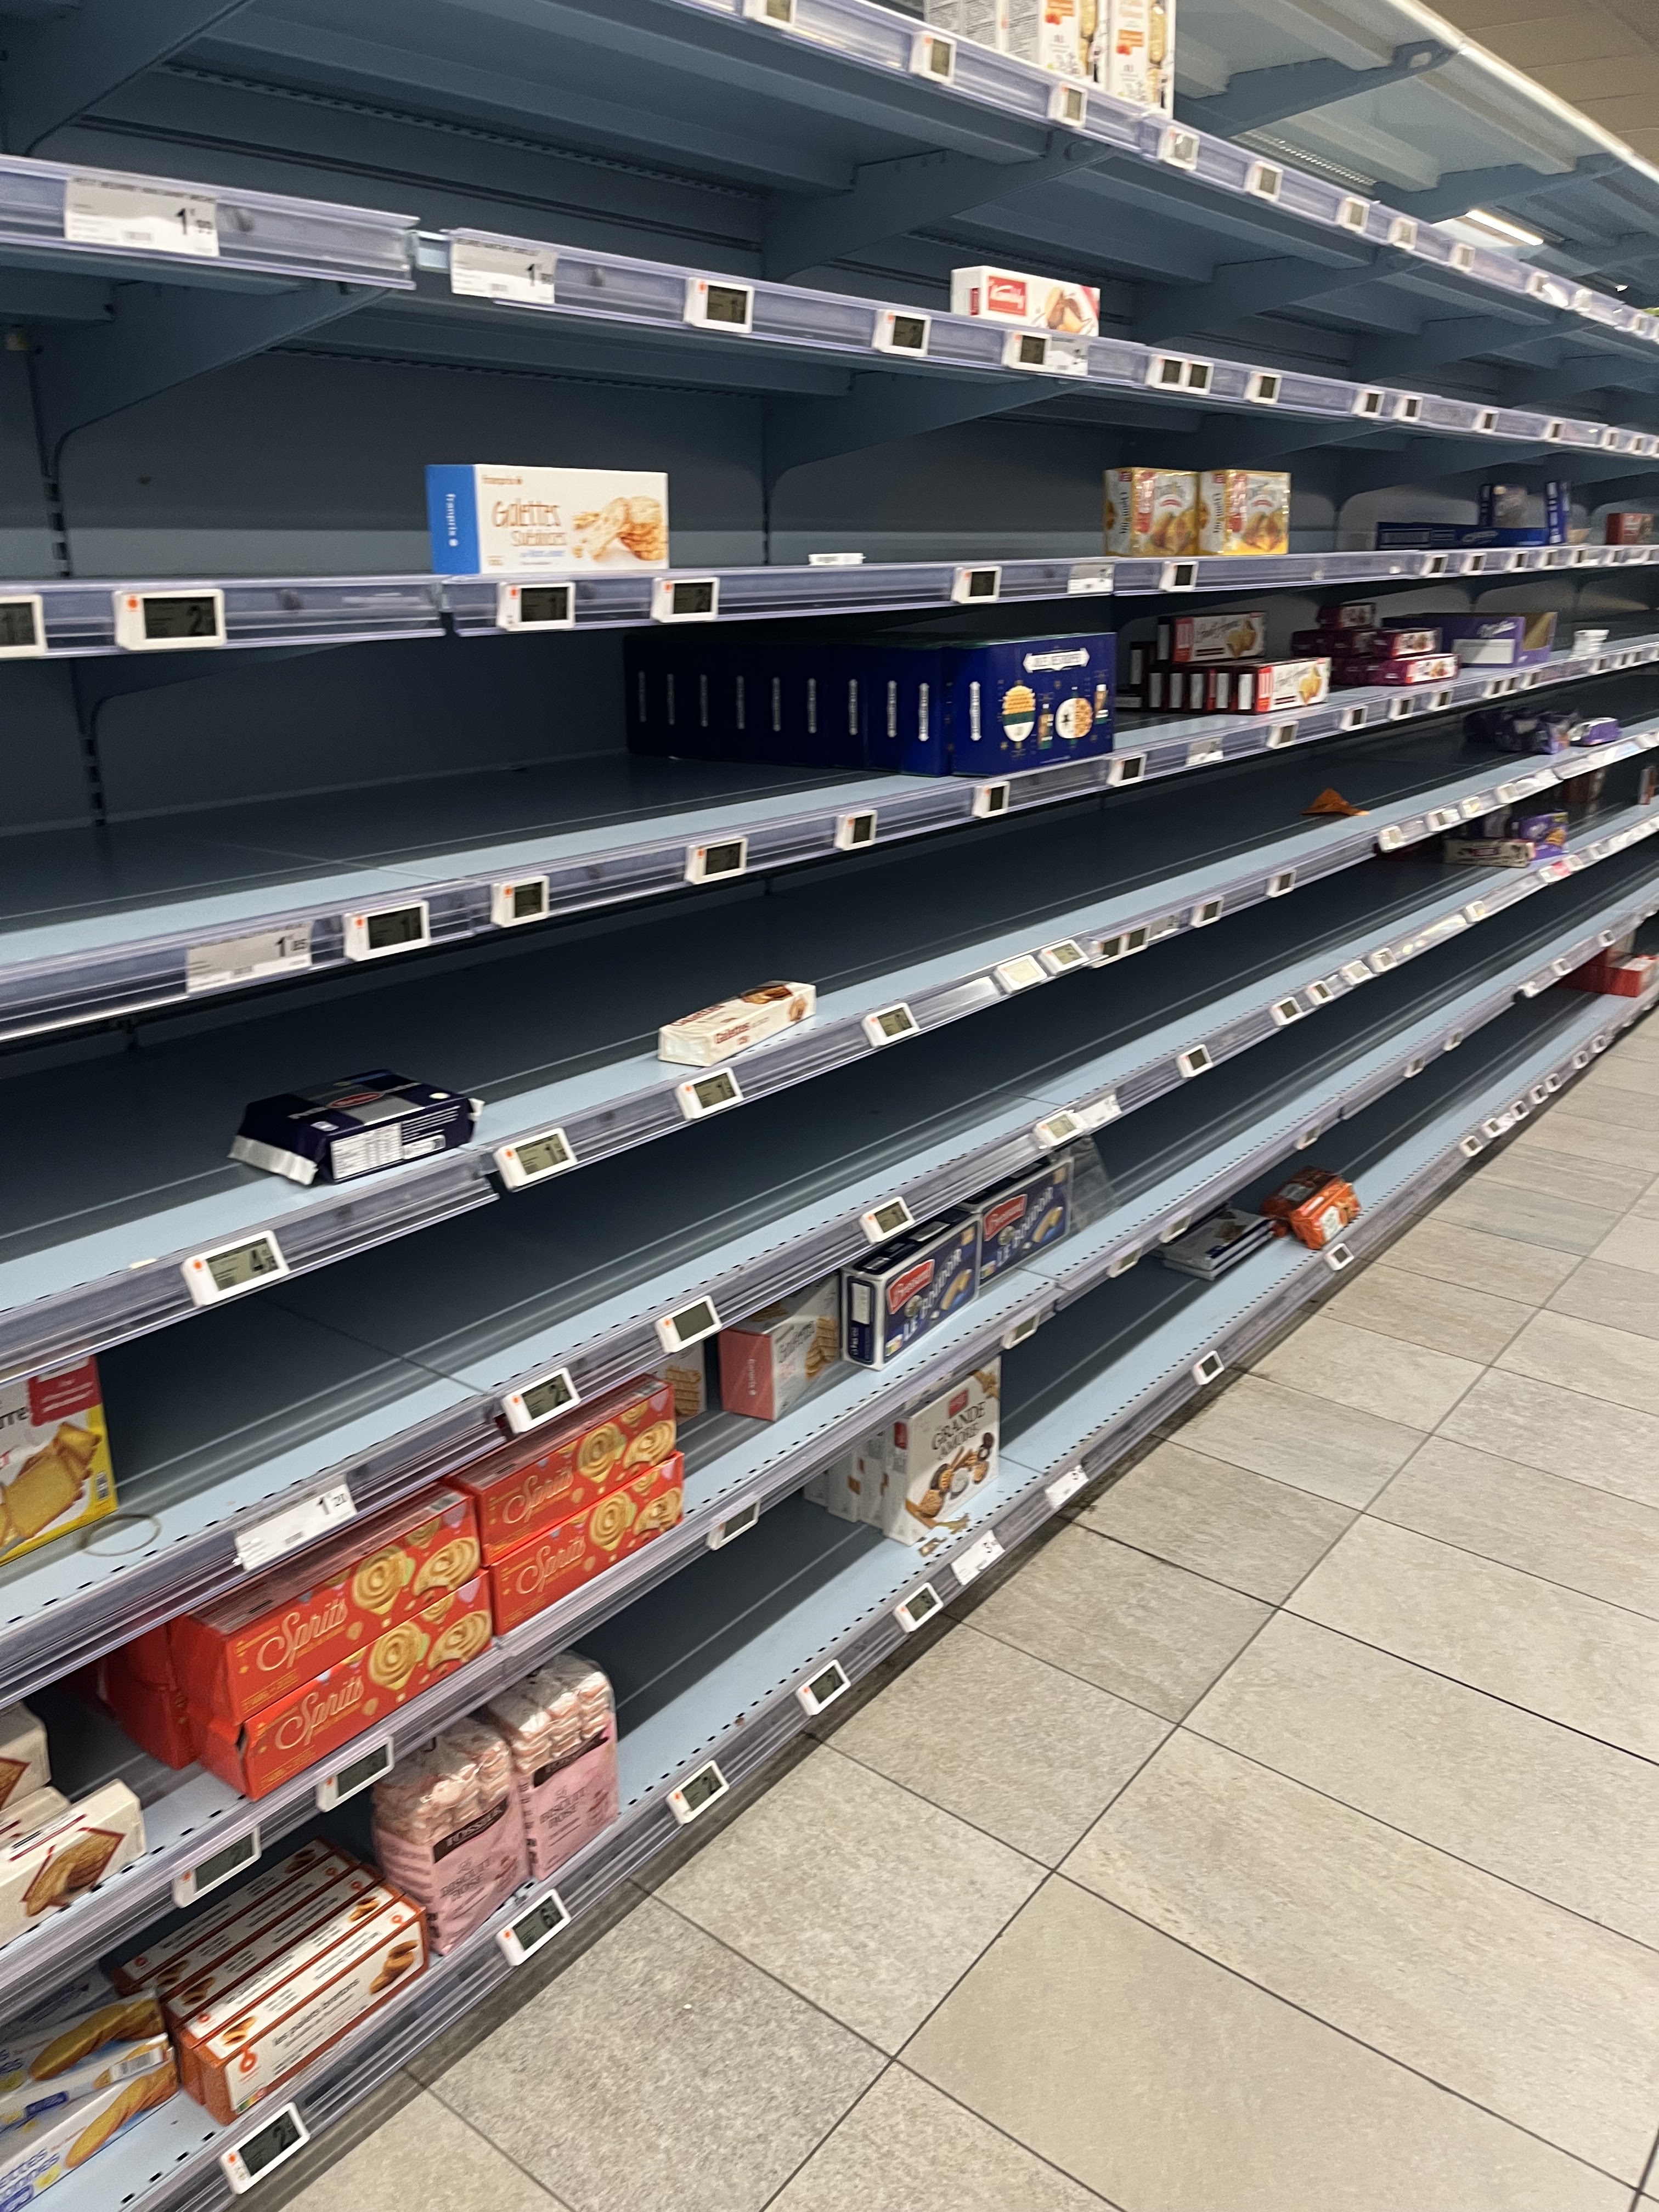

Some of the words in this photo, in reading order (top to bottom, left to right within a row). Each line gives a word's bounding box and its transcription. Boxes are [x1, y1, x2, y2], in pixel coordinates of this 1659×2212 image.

[175, 208, 187, 235] 1
[525, 263, 535, 287] 1
[185, 605, 203, 636] 2
[274, 937, 287, 957] 1
[315, 1496, 330, 1516] 1
